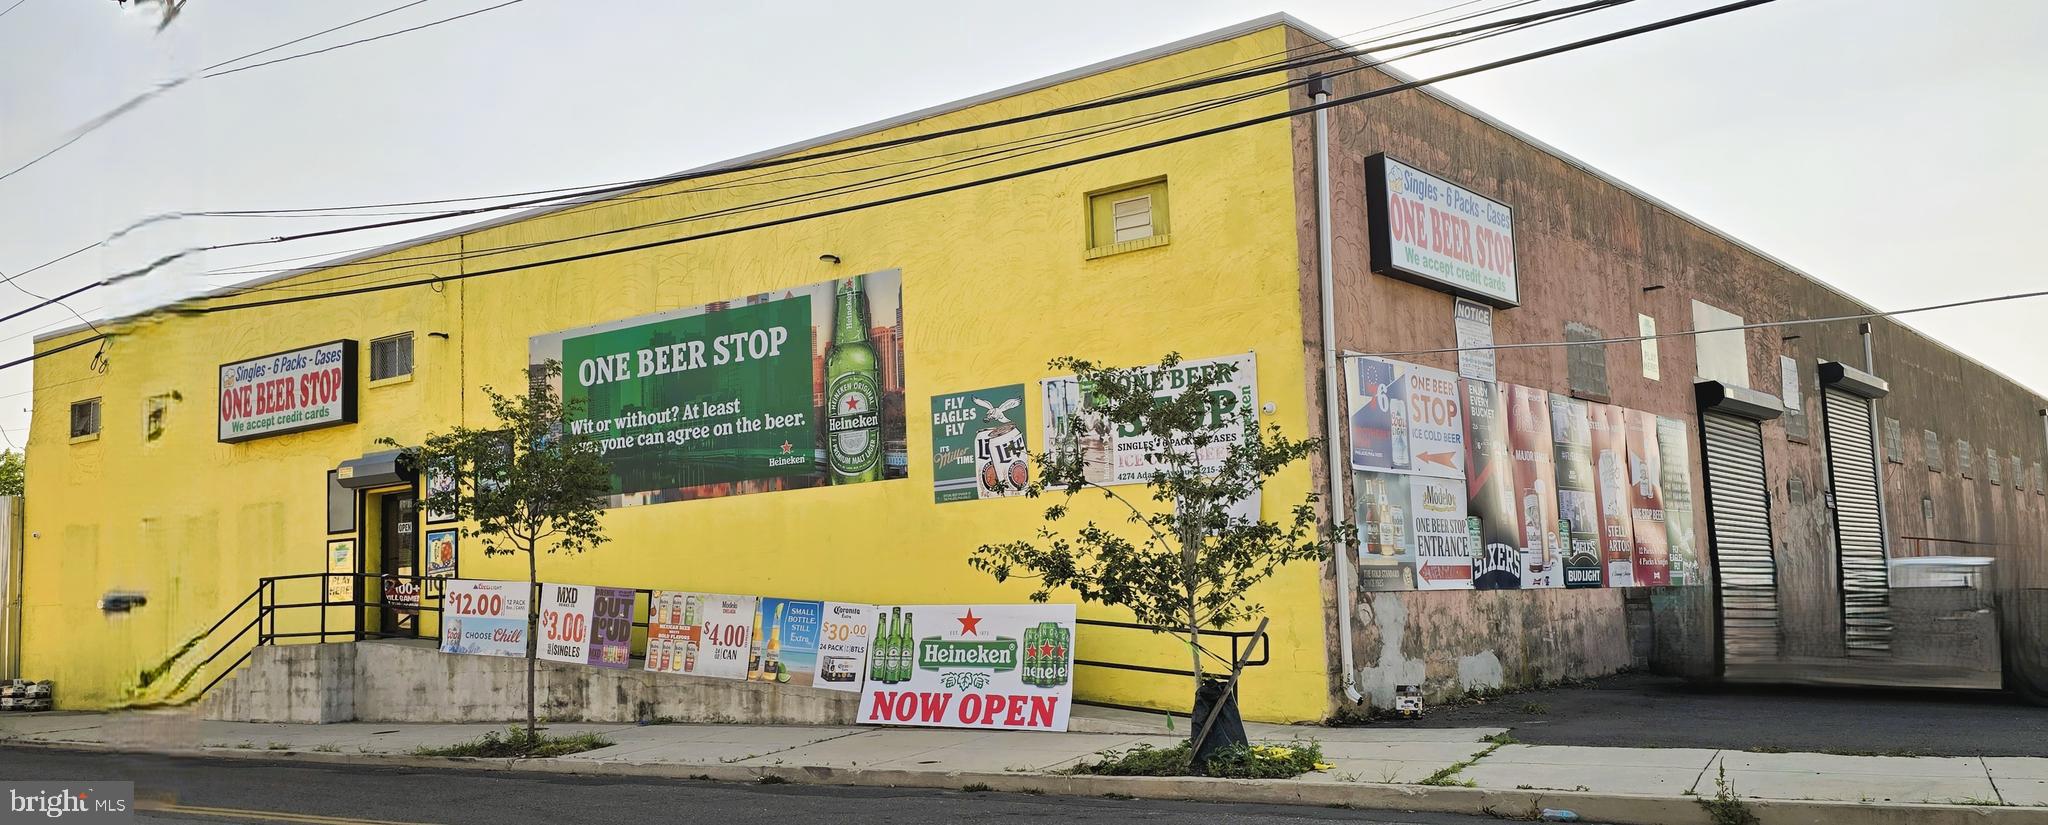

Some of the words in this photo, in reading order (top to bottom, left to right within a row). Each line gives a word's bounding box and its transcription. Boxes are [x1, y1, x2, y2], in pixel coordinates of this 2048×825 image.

[1404, 170, 1438, 201] Singles
[1446, 187, 1452, 207] 6
[1454, 190, 1480, 218] Packs
[1486, 202, 1510, 228] Cases
[1390, 192, 1428, 250] ONE
[1430, 207, 1474, 264] BEER
[1476, 224, 1512, 278] STOP
[1404, 246, 1420, 266] We
[1422, 254, 1454, 276] accept
[1456, 266, 1481, 286] credit
[1484, 274, 1506, 292] cards
[1458, 304, 1490, 324] NOTICE
[235, 362, 265, 382] Singles
[273, 358, 278, 374] 6
[281, 354, 306, 372] Packs
[314, 349, 342, 366] Cases
[578, 352, 631, 387] ONE
[637, 340, 706, 378] BEER
[713, 326, 788, 366] STOP
[1170, 363, 1233, 390] BEER
[1411, 374, 1430, 392] ONE
[1432, 377, 1454, 396] BEER
[222, 384, 252, 422] ONE
[256, 376, 296, 415] BEER
[300, 368, 342, 408] STOP
[832, 382, 852, 410] HEINEKEN
[854, 382, 875, 405] ORIGINAL
[1468, 384, 1488, 397] ENJOY
[944, 396, 965, 410] FLY
[1410, 393, 1458, 427] STOP
[1470, 396, 1488, 407] EVERY
[232, 421, 244, 432] We
[246, 416, 274, 430] accept
[277, 410, 302, 424] credit
[305, 406, 330, 419] cards
[571, 418, 594, 435] Wit
[596, 420, 612, 432] or
[614, 406, 680, 429] without?
[682, 404, 700, 420] At
[703, 398, 740, 418] least
[934, 408, 976, 424] EAGLES
[1472, 406, 1494, 418] BUCKET
[638, 432, 664, 446] can
[667, 425, 710, 445] agree
[713, 422, 733, 436] on
[736, 416, 762, 434] the
[764, 412, 806, 430] beer.
[829, 415, 879, 432] Heineken
[946, 422, 965, 436] FLY
[1118, 440, 1154, 452] SINGLES
[1412, 429, 1422, 439] ICE
[1424, 430, 1442, 442] COLD
[1444, 432, 1461, 444] BEER
[769, 455, 806, 467] Heineken
[832, 444, 850, 464] PREMIUM
[852, 454, 866, 464] MALT
[864, 439, 876, 458] LAGER
[934, 447, 970, 470] Miller
[956, 455, 974, 464] TIME
[1426, 486, 1452, 506] Modelo
[399, 524, 412, 532] OPEN
[1416, 518, 1430, 532] ONE
[1432, 518, 1448, 533] BEER
[1450, 520, 1466, 534] STOP
[1417, 536, 1470, 557] ENTRANCE
[1573, 540, 1598, 560] EAGLES
[1474, 542, 1520, 580] SIXERS
[1568, 569, 1582, 581] BUD
[1583, 570, 1600, 582] LIGHT
[449, 592, 502, 616] $12.00
[556, 586, 578, 604] MXD
[722, 601, 738, 609] Modelo
[594, 596, 634, 618] OUT
[792, 608, 814, 616] SMALL
[834, 606, 860, 615] Coronita
[542, 608, 584, 642] $3.00
[704, 621, 745, 648] $4.00
[792, 624, 810, 632] STILL
[823, 621, 867, 641] $30.00
[465, 632, 492, 640] CHOOSE
[494, 628, 522, 643] Chill
[553, 644, 580, 658] SINGLES
[722, 649, 738, 660] CAN
[925, 644, 1011, 664] Heineken
[870, 690, 952, 722] NOW
[958, 693, 1058, 727] OPEN
